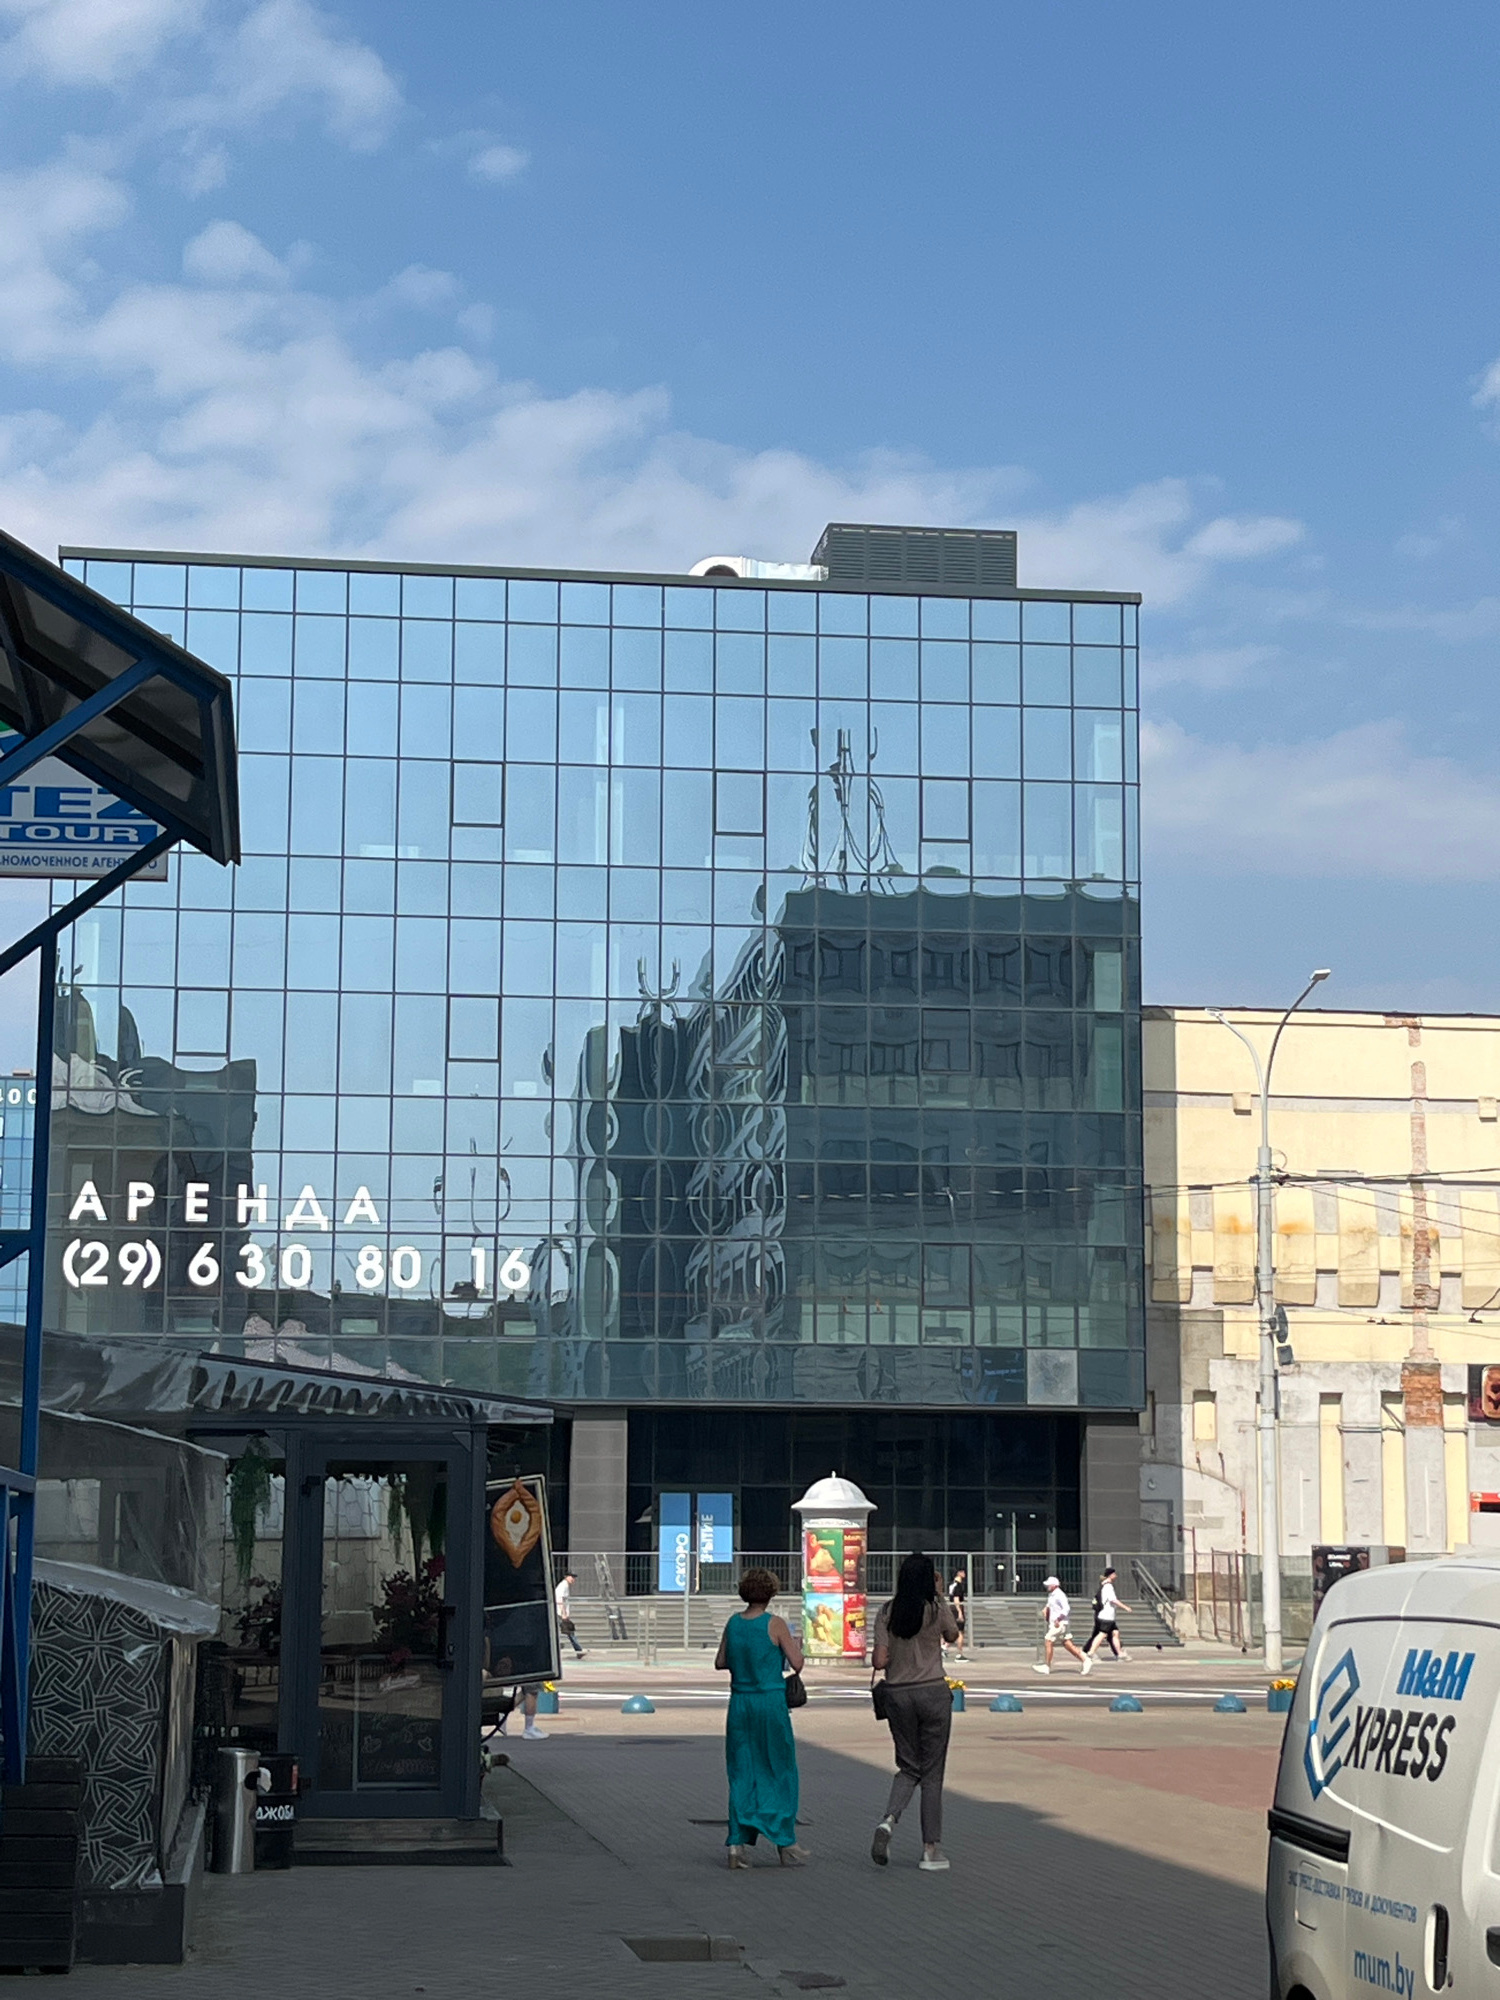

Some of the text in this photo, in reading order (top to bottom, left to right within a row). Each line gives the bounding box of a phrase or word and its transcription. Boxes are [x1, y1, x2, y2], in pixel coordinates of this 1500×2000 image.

[0, 823, 139, 843] TOUR
[0, 855, 88, 868] НОМОЧЕННОЕ
[68, 1180, 381, 1231] АРЕНДА
[62, 1238, 530, 1289] (29) 630 80 16
[675, 1533, 689, 1587] СКОРО
[1396, 1648, 1476, 1701] M&M
[1354, 1949, 1415, 2000] mum.by
